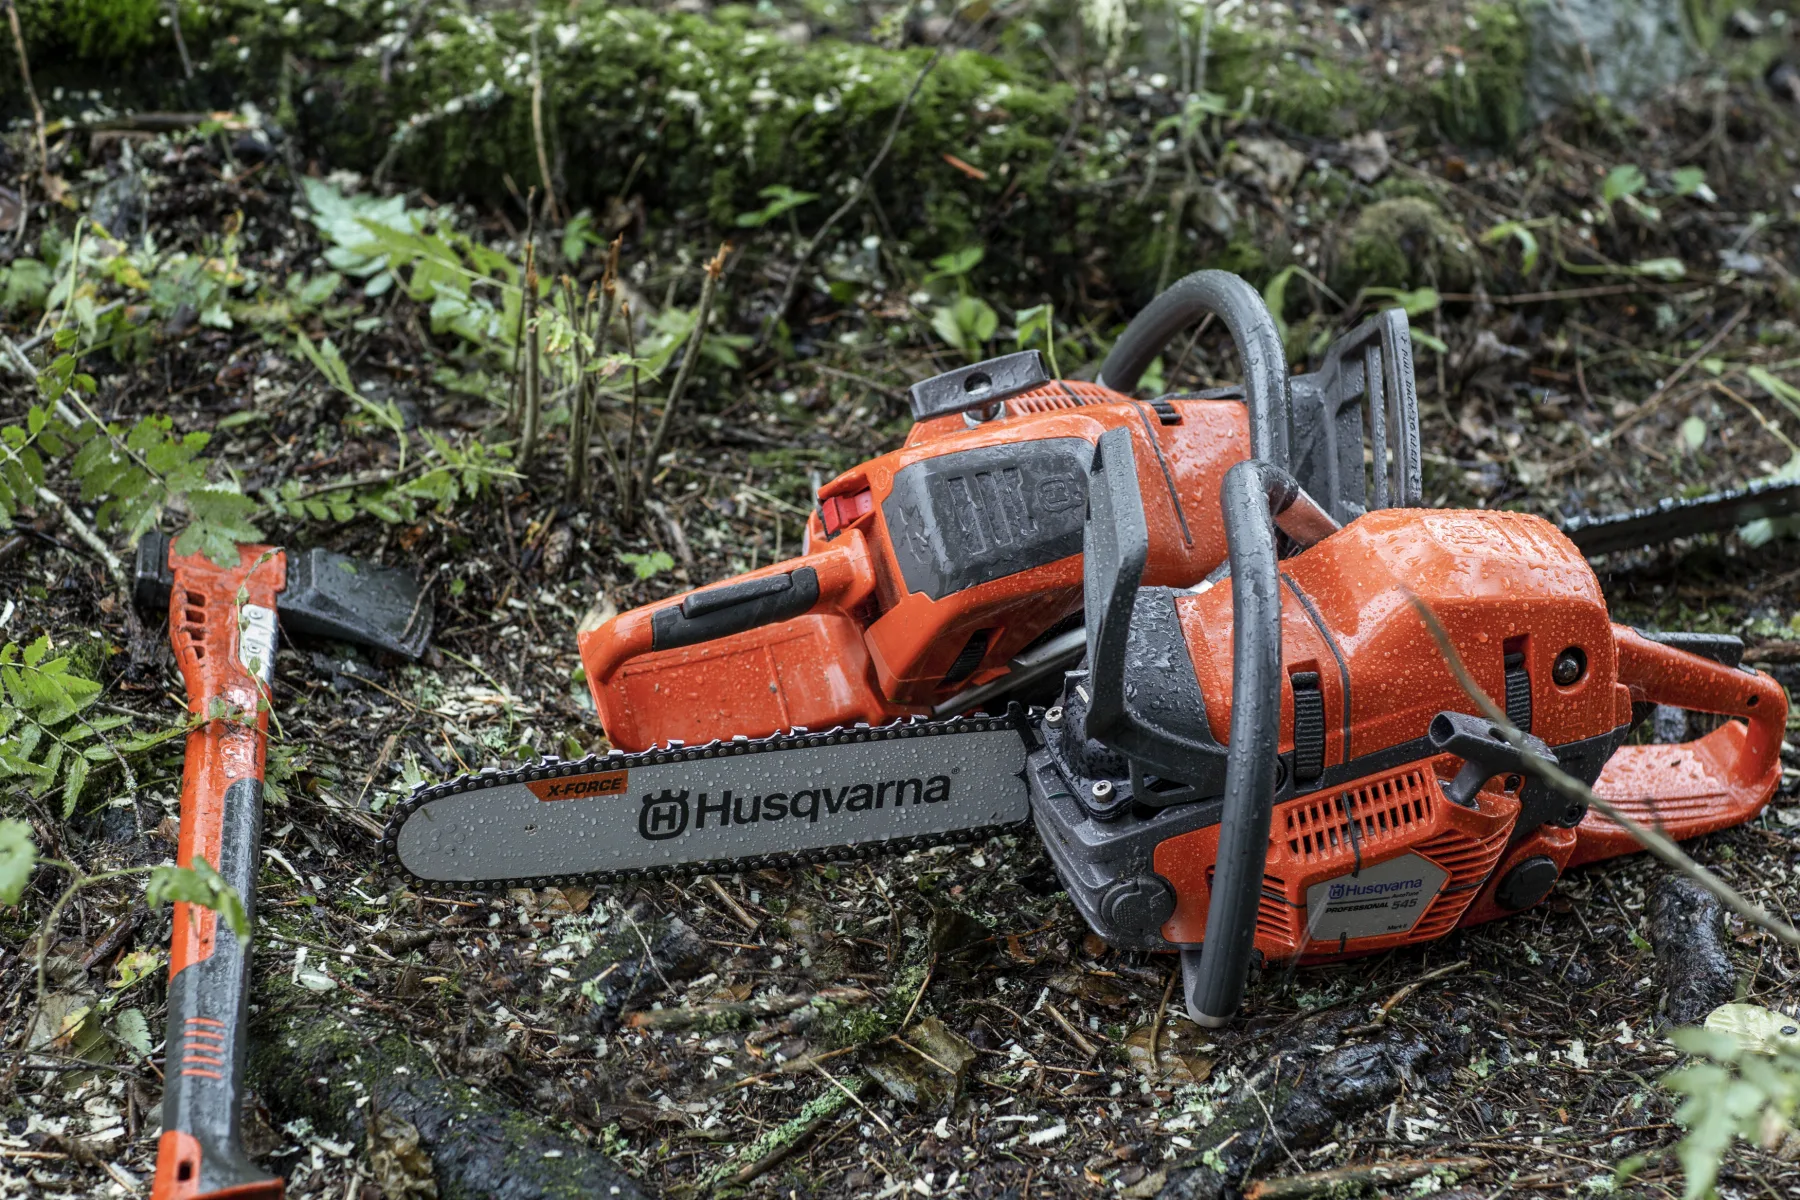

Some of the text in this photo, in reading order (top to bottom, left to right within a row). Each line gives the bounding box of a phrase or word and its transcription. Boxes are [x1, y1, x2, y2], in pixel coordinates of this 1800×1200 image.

[547, 778, 623, 797] X-FORCE
[695, 775, 952, 828] Husqvarna
[1346, 878, 1423, 897] Husqvarna
[1325, 898, 1418, 913] PROFESSIONAL 545
